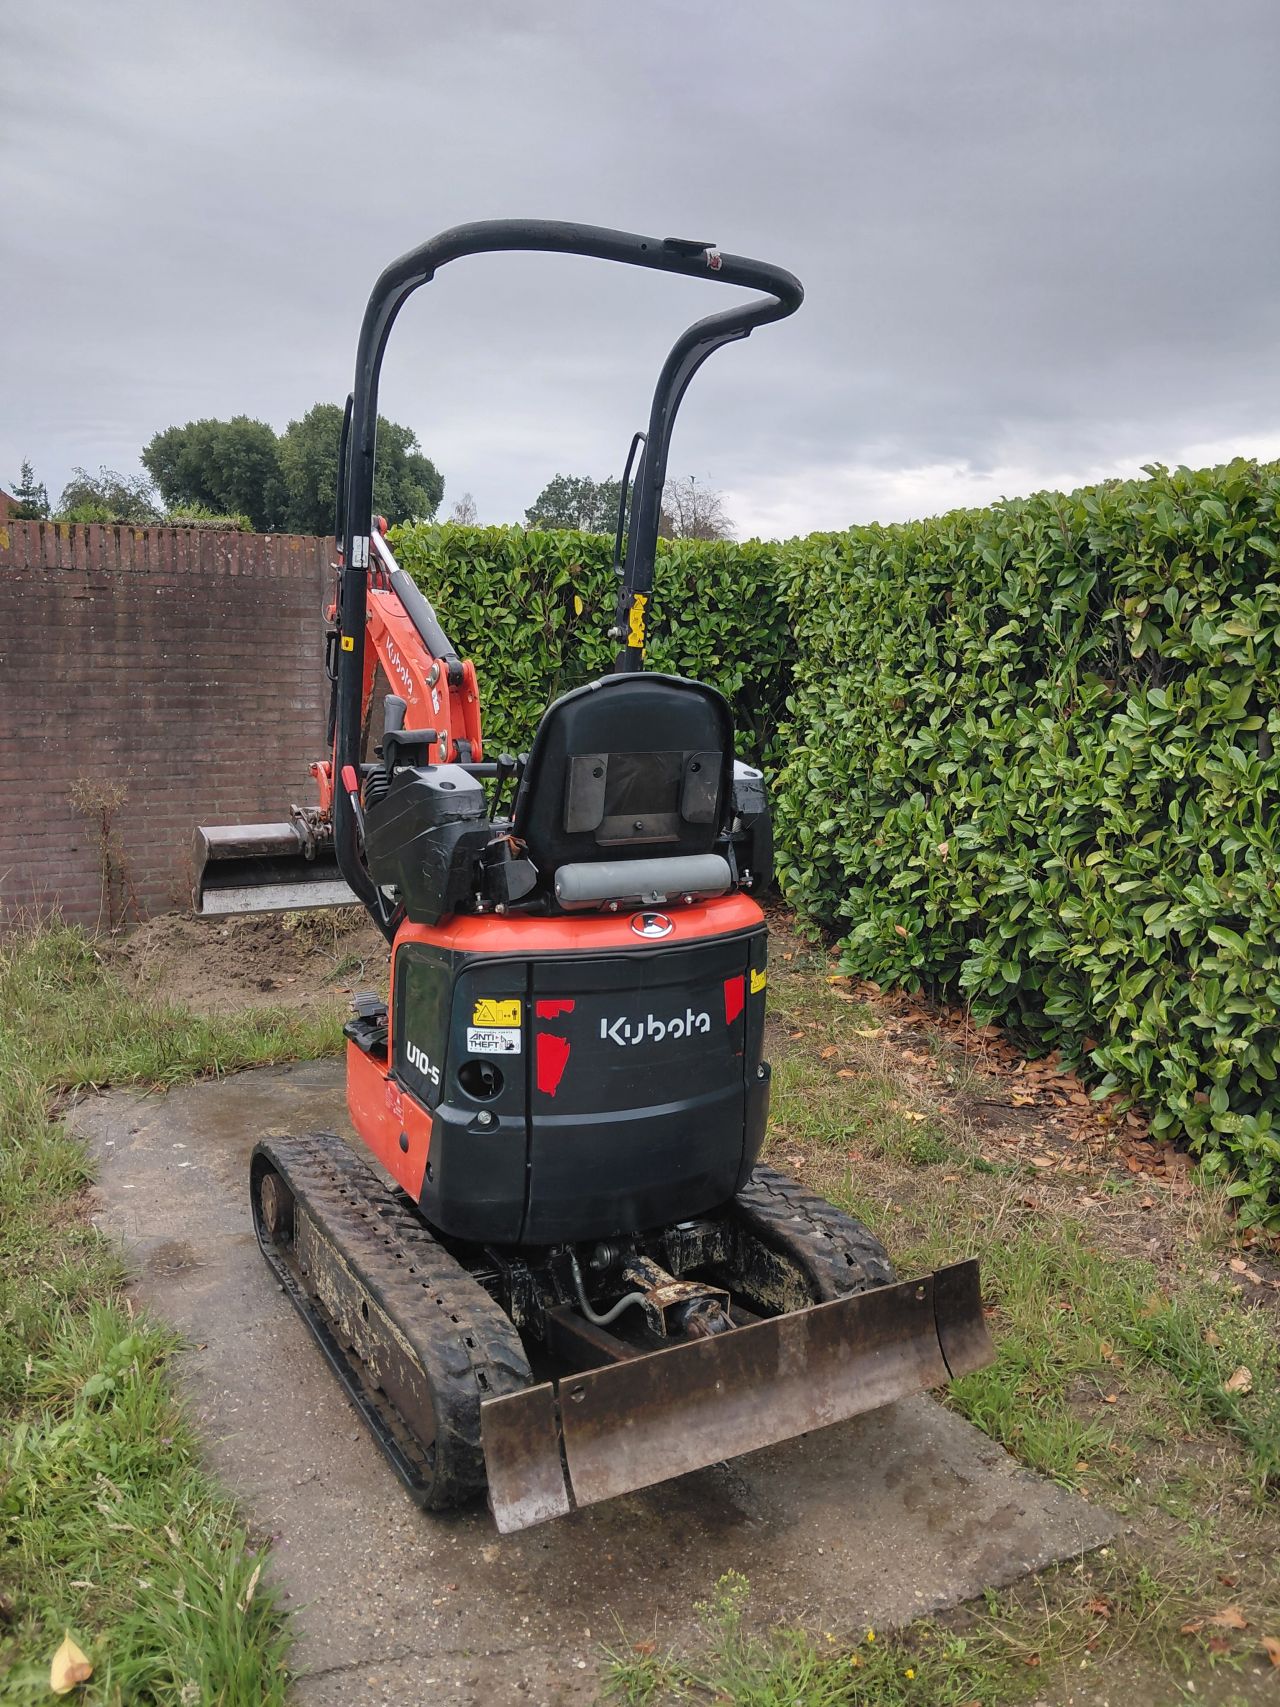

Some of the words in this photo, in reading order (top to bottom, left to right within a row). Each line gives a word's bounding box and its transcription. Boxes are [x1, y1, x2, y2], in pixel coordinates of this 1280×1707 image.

[386, 636, 413, 695] Kubota
[469, 1033, 495, 1041] ANTI
[469, 1040, 499, 1048] THEFT
[600, 1008, 711, 1046] Kubota
[406, 1040, 440, 1085] U10-5
